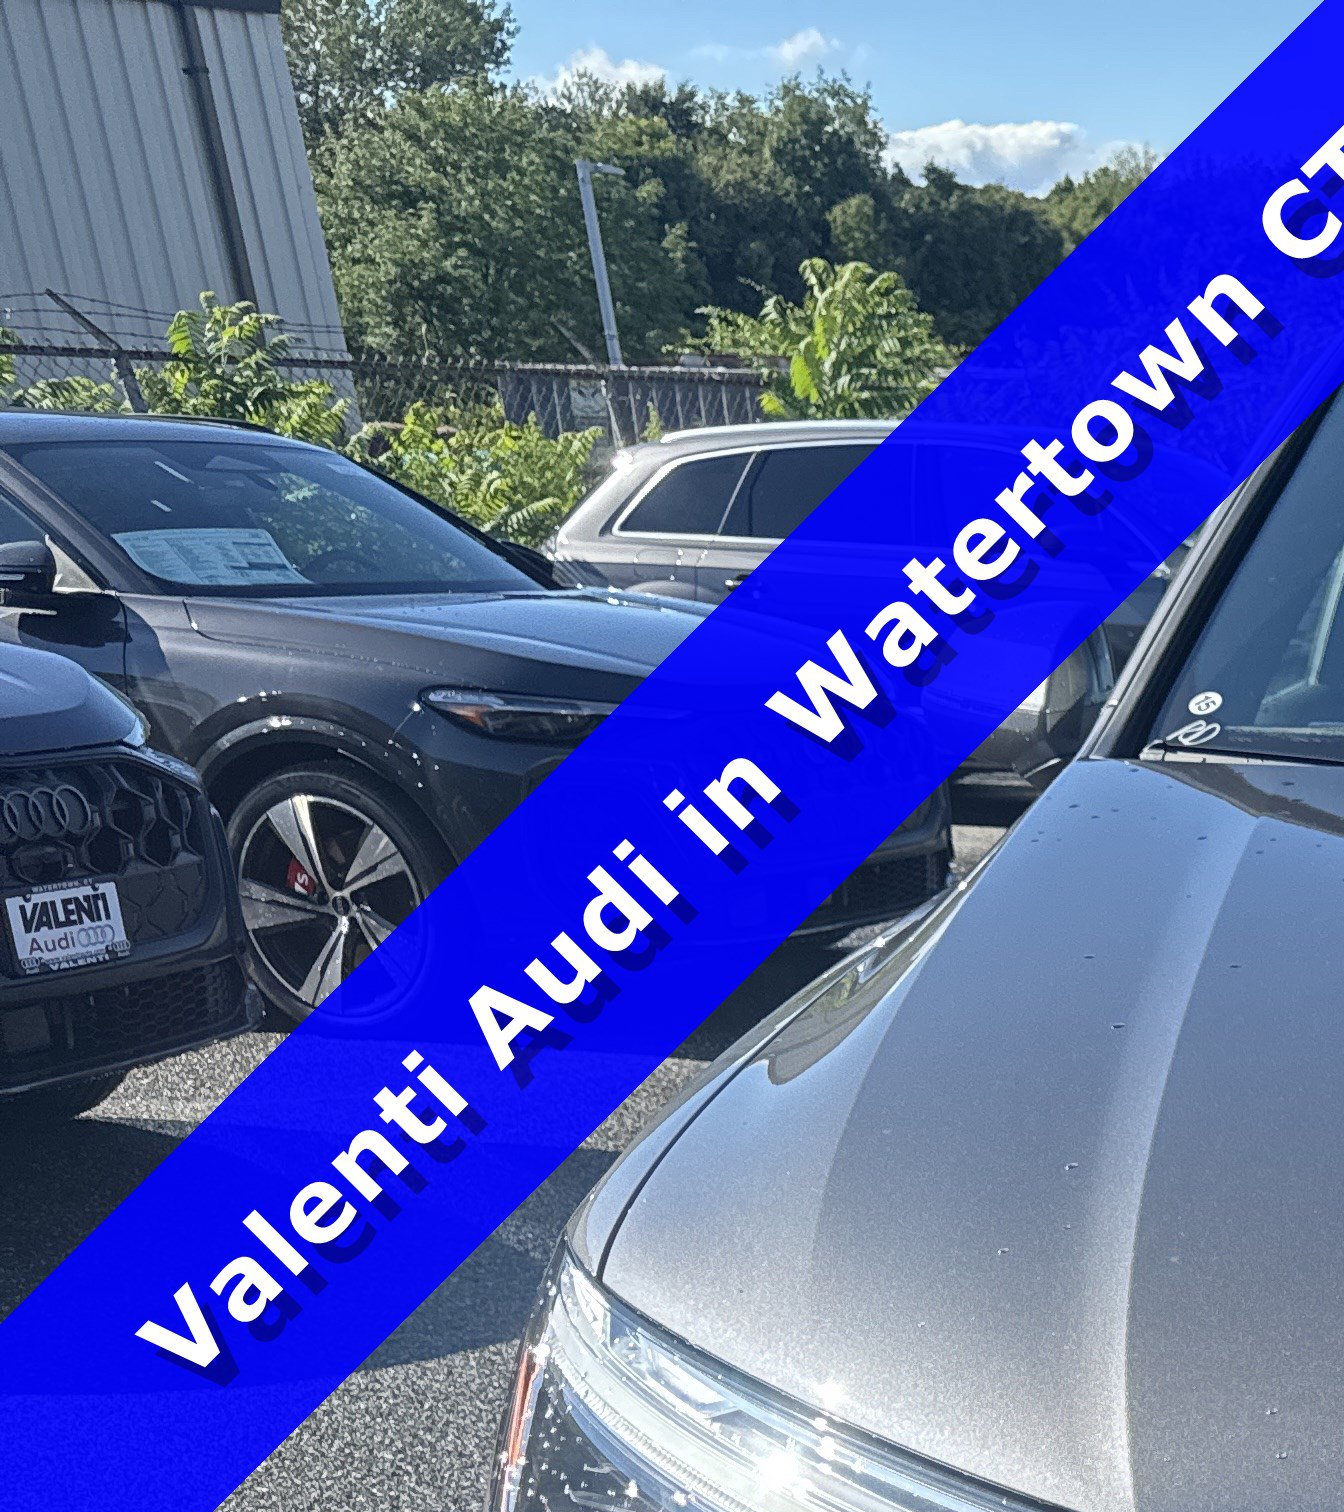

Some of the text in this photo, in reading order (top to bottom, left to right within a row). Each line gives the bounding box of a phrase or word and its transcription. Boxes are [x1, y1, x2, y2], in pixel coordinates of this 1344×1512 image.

[1194, 695, 1217, 712] 15
[18, 892, 112, 934] VALENTI
[28, 930, 76, 956] Audi
